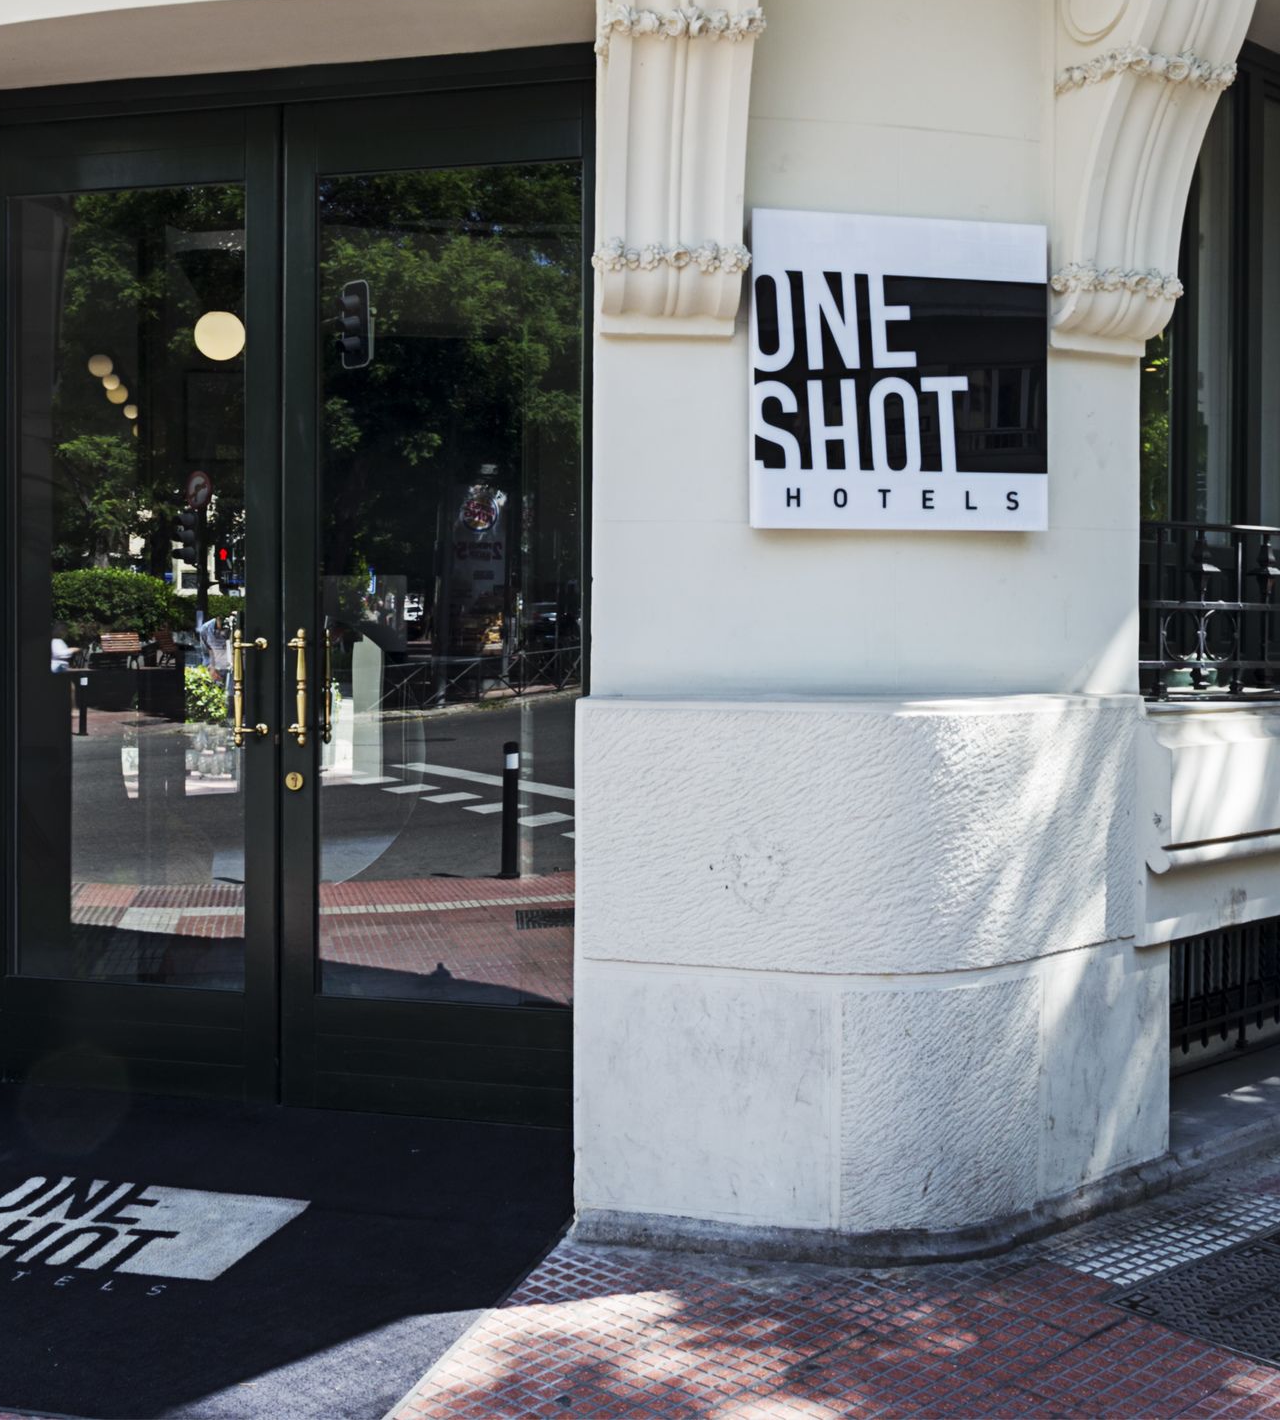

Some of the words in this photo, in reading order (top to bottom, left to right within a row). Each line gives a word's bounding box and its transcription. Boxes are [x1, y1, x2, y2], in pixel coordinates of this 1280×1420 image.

[754, 270, 917, 372] ONE
[754, 375, 969, 473] SHOT
[786, 486, 1020, 512] HOTELS
